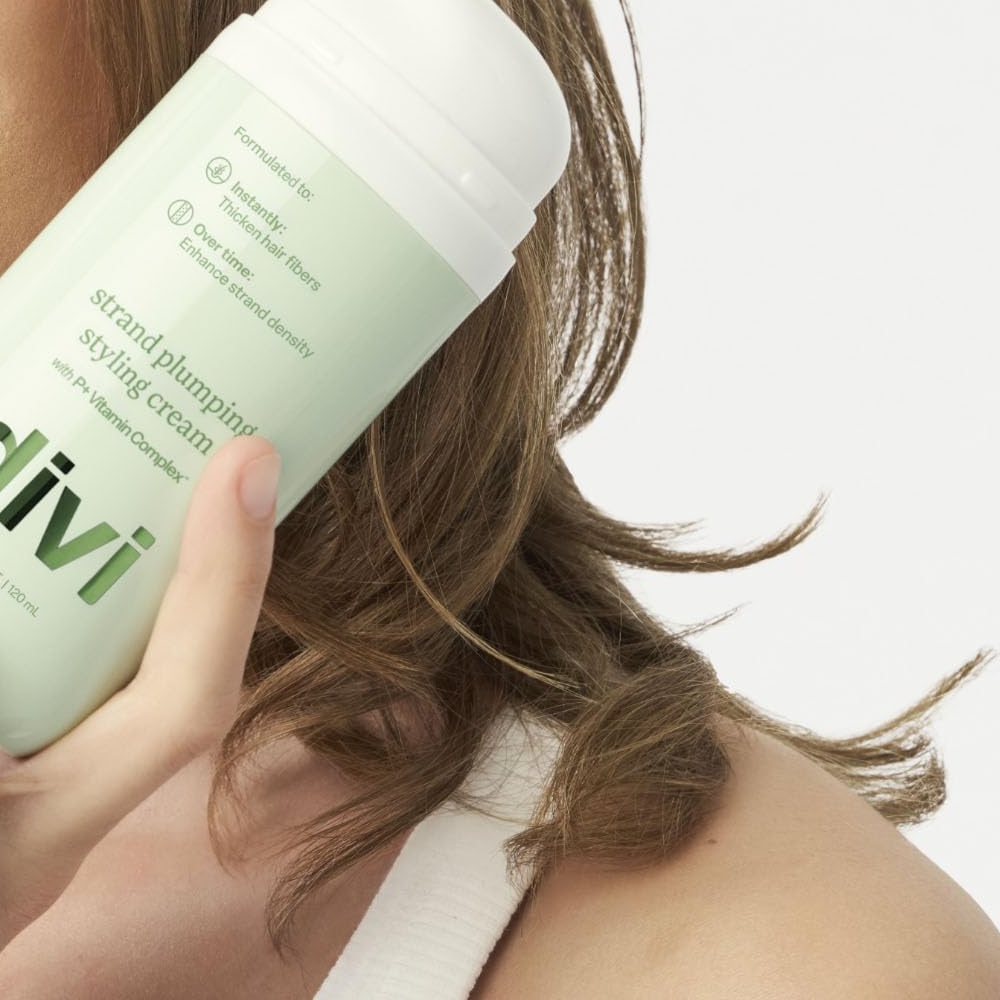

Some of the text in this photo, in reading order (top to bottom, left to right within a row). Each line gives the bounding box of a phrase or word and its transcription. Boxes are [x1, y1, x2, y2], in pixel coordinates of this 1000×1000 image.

[233, 125, 315, 203] Formulated to:
[218, 196, 322, 292] Thicken hair fibers
[230, 180, 288, 235] Instantly:
[193, 223, 255, 281] Over time:
[89, 288, 164, 355] strand
[179, 236, 315, 360] Enhance strand density
[51, 357, 75, 381] with
[72, 375, 90, 394] P+
[89, 390, 133, 437] Vitamin
[79, 328, 214, 456] styling cream
[7, 584, 26, 603] 120
[23, 600, 40, 618] mL
